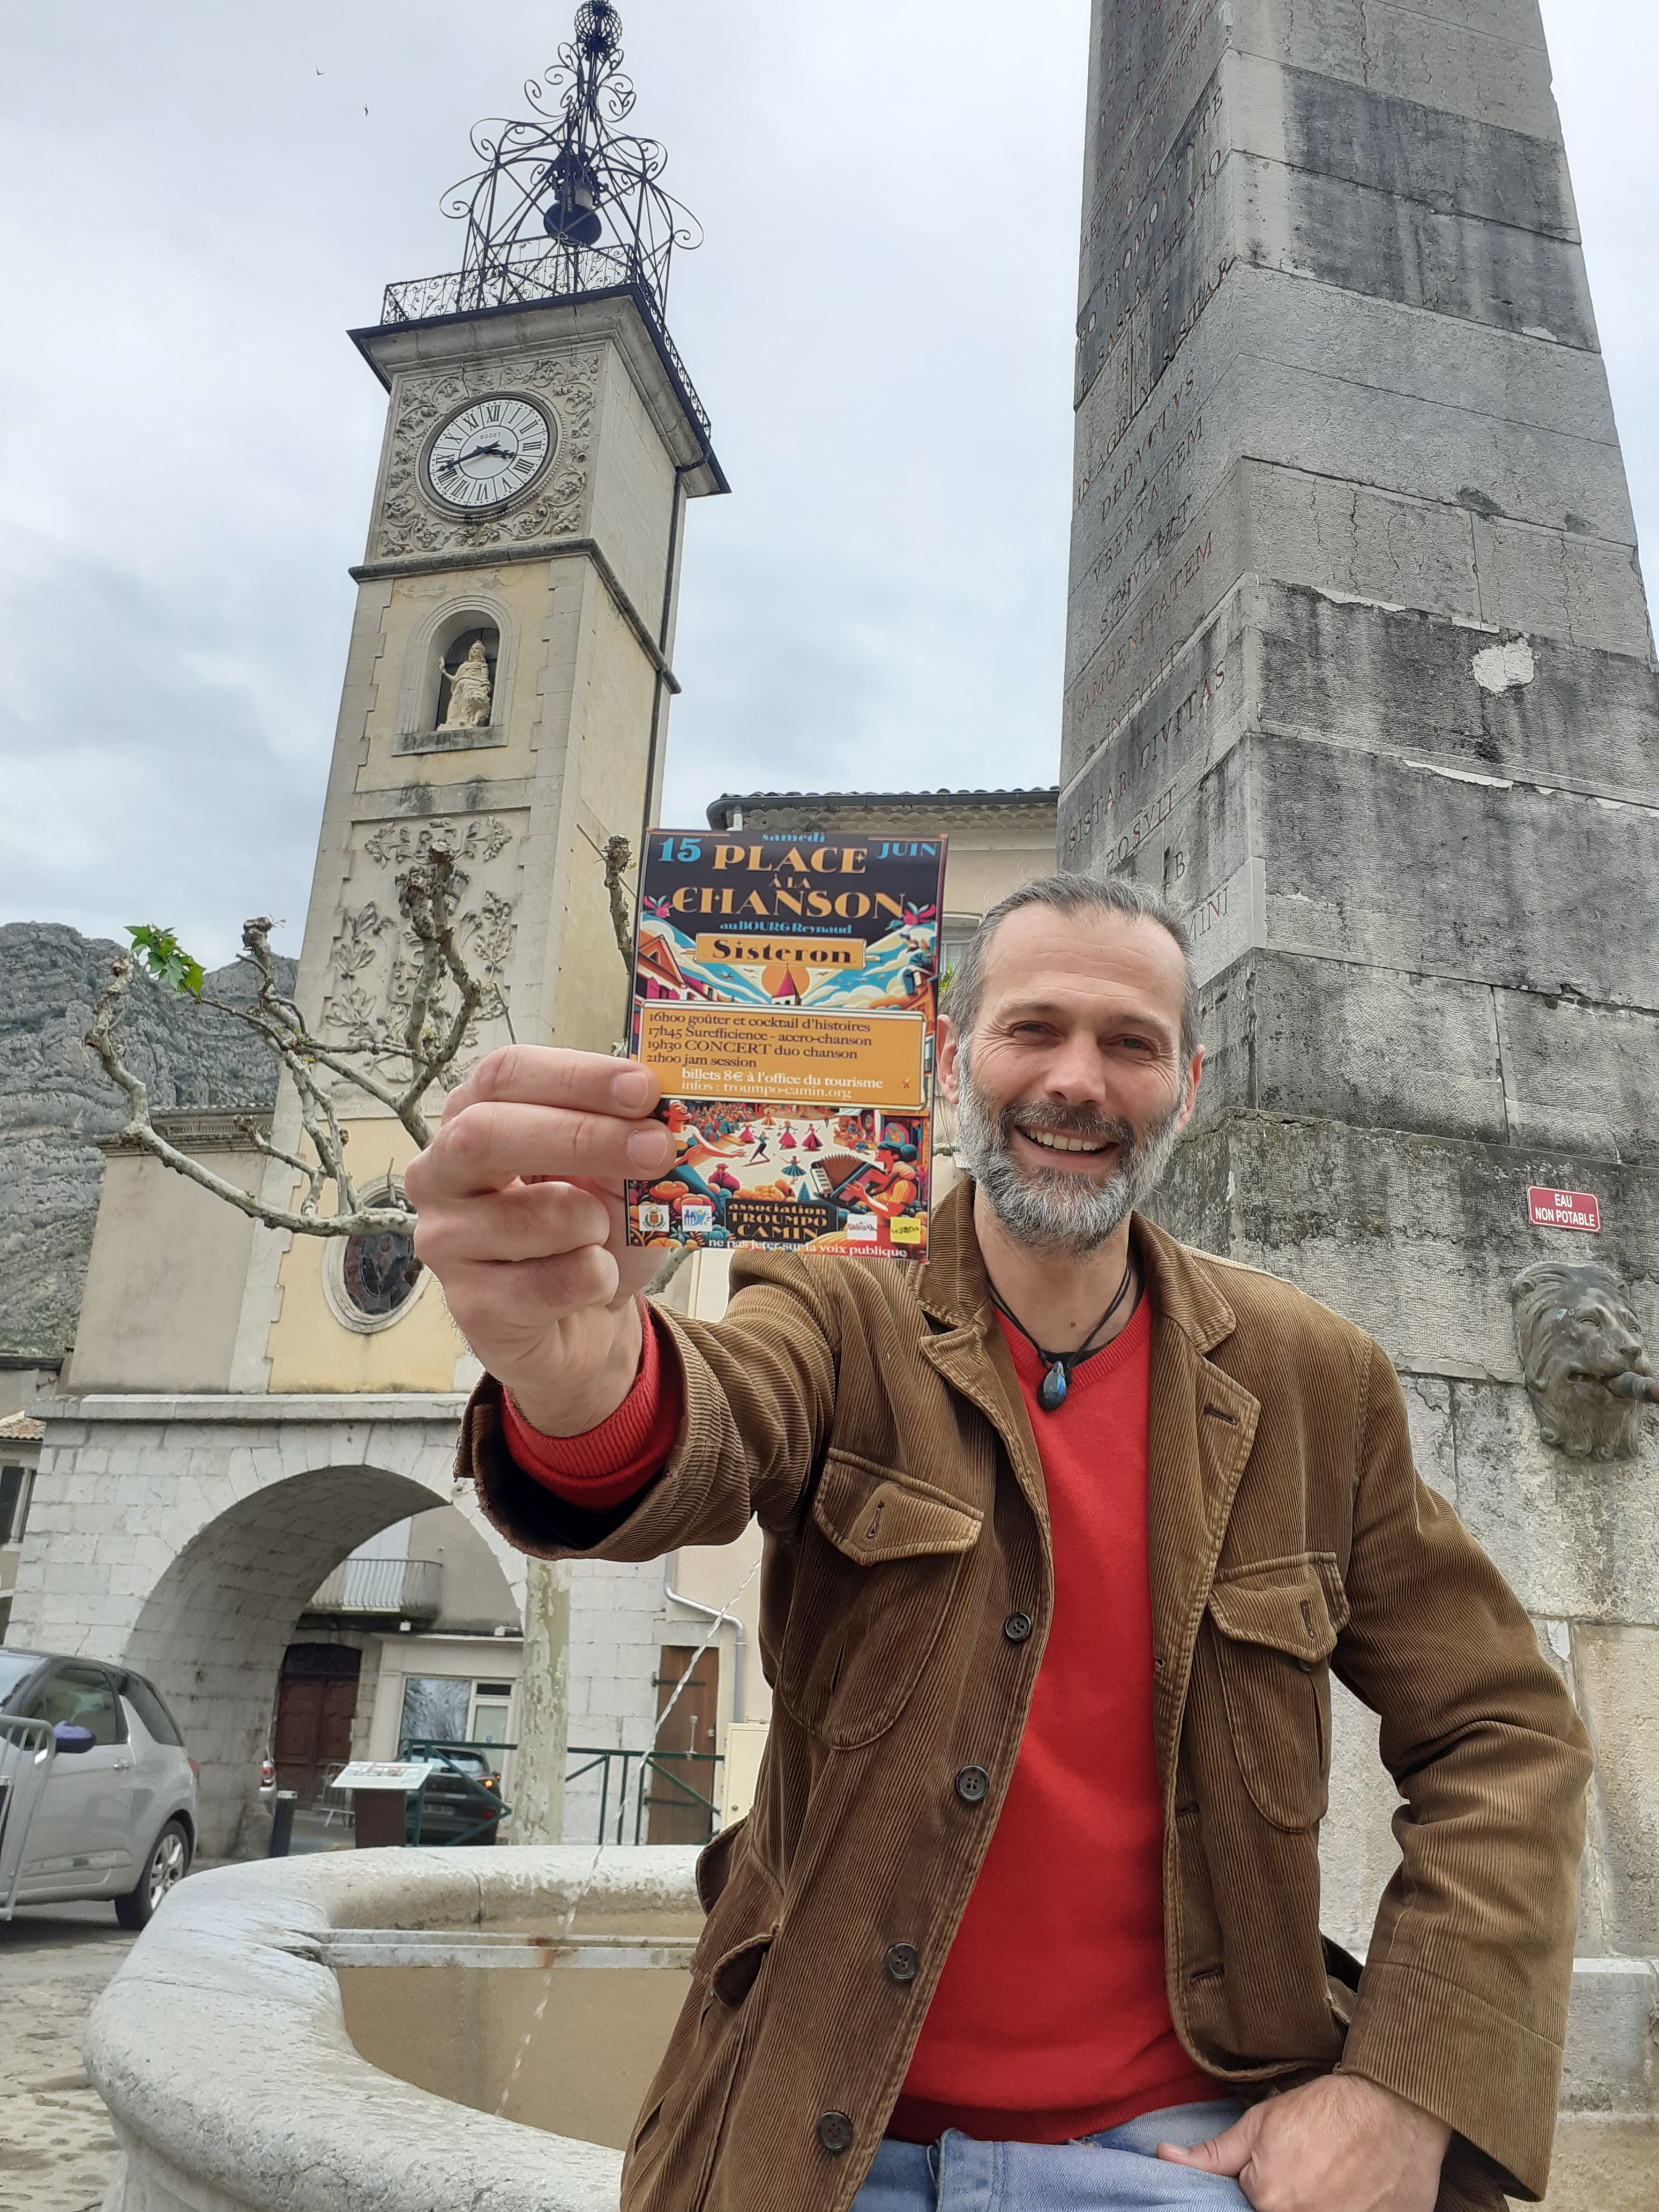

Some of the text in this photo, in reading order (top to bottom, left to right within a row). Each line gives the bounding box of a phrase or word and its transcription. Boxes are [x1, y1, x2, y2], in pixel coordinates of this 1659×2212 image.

[461, 413, 480, 431] XI
[485, 405, 502, 423] XII
[444, 432, 464, 445] X
[1094, 417, 1202, 582] VBERTATEM
[1082, 533, 1212, 715] AMOENITATEM
[1141, 660, 1225, 771] CIVITAS
[1106, 783, 1177, 871] POSVIT
[762, 832, 825, 843] samedi
[659, 837, 937, 874] 15 PLACE JUIN
[768, 873, 811, 889] À LA
[672, 886, 906, 920] CHANSON
[712, 939, 852, 963] Sisteron
[649, 1012, 871, 1032] 16h00 goûter et cocktail d'histoires
[648, 1025, 683, 1039] 17h45
[685, 1026, 768, 1040] Surefficience
[778, 1033, 872, 1047] accro-chanson
[647, 1039, 858, 1059] 19h30 CONCERT duo chanson
[646, 1052, 757, 1068] 21h00 jam session
[682, 1067, 884, 1089] billets 8€ à l'office du tourisme
[682, 1079, 713, 1090] infos
[724, 1083, 852, 1101] troumpo-camin.org
[728, 1203, 827, 1215] association
[1555, 1194, 1572, 1208] EAU
[728, 1212, 828, 1227] TROUMPO
[1535, 1207, 1596, 1227] NON POTABLE
[737, 1224, 818, 1239] CAMIN
[727, 1240, 749, 1249] pas
[805, 1242, 816, 1252] la
[819, 1243, 847, 1253] voix
[849, 1245, 907, 1258] publique
